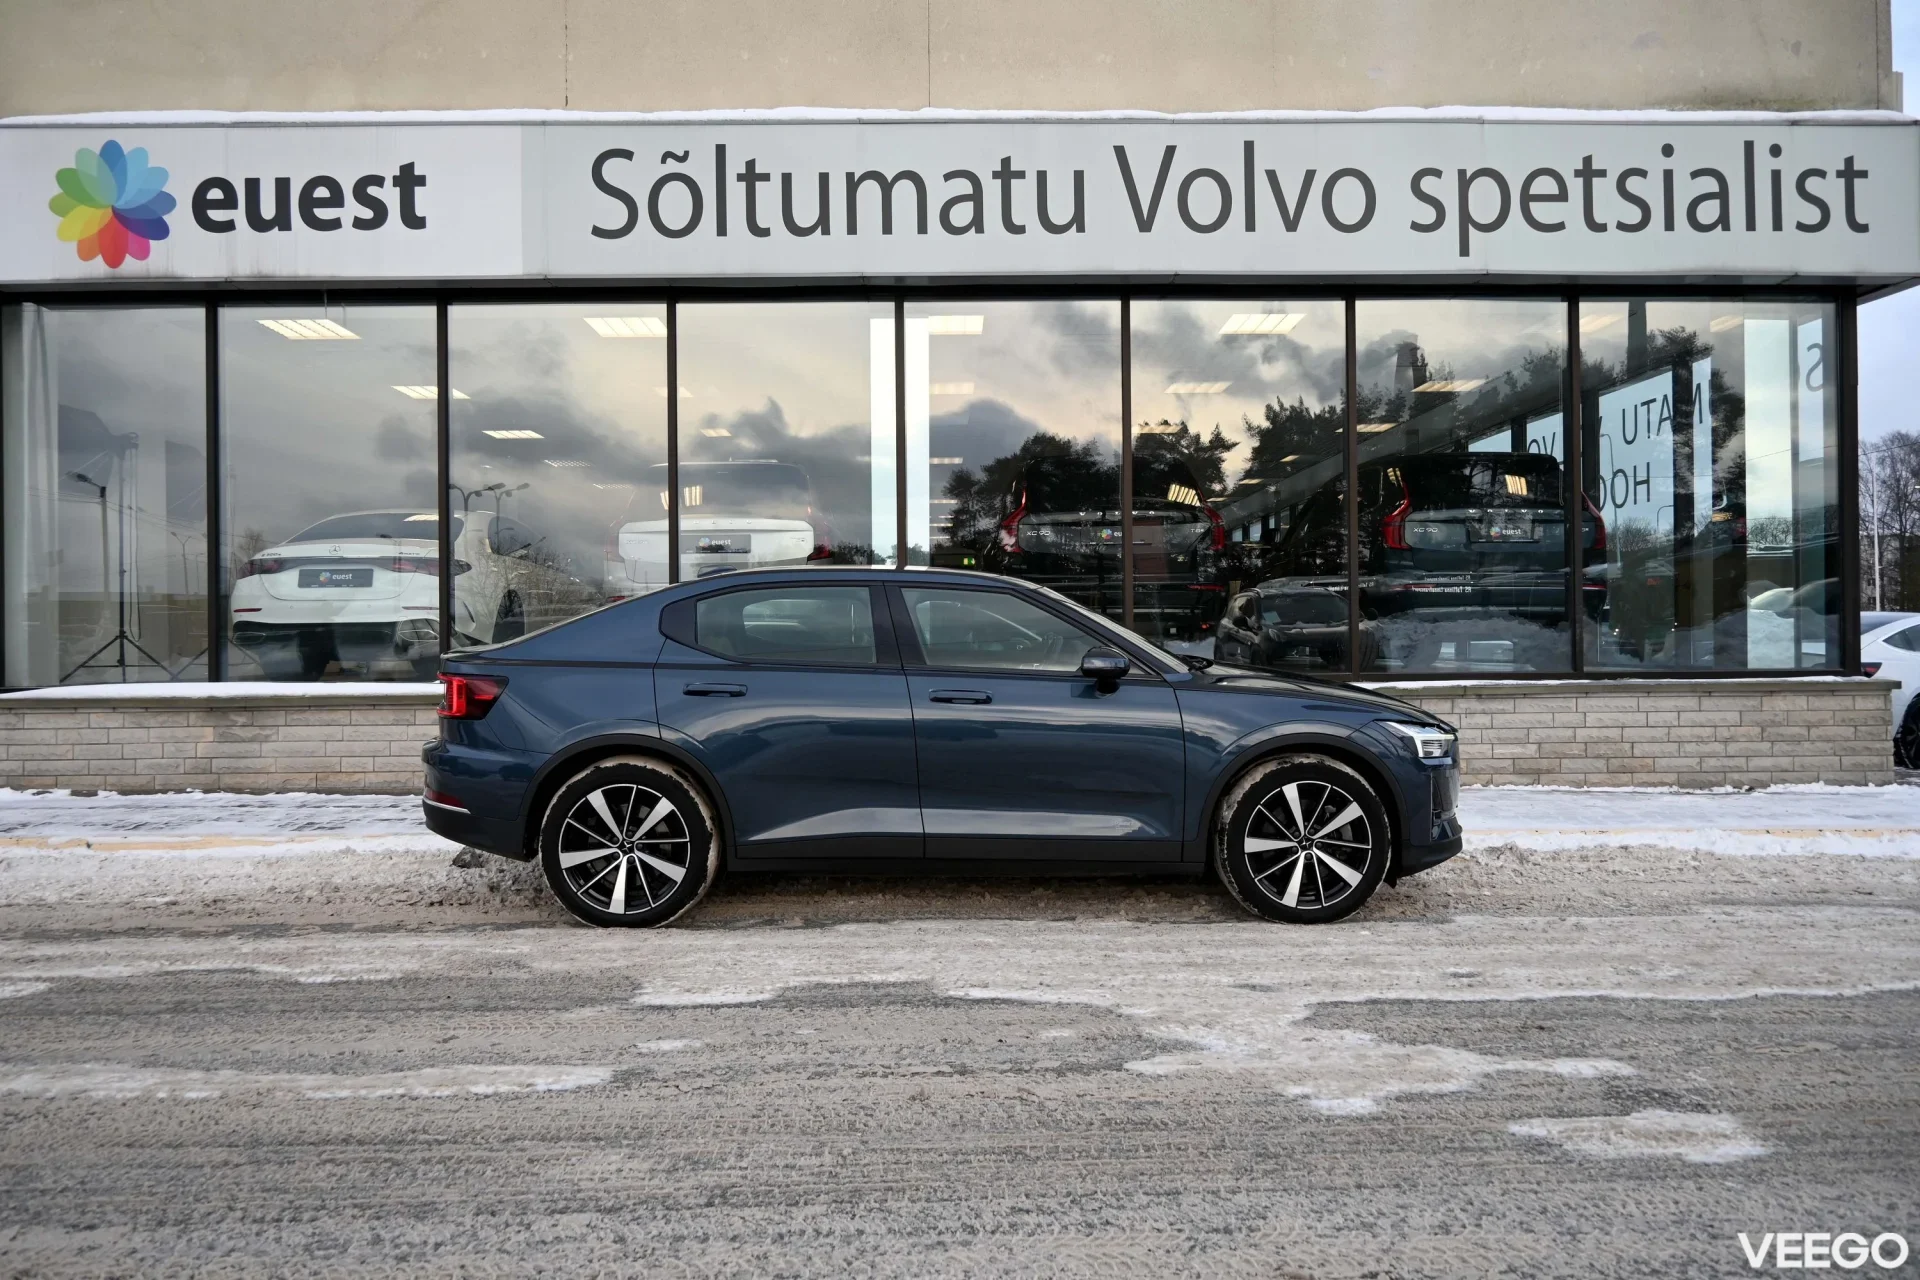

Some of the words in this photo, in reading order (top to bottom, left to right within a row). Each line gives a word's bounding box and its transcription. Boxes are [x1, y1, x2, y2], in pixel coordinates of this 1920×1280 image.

[192, 161, 427, 234] euest
[590, 143, 1086, 241] Sõltumatu
[1113, 140, 1378, 236] Volvo
[1408, 140, 1870, 258] spetsialist
